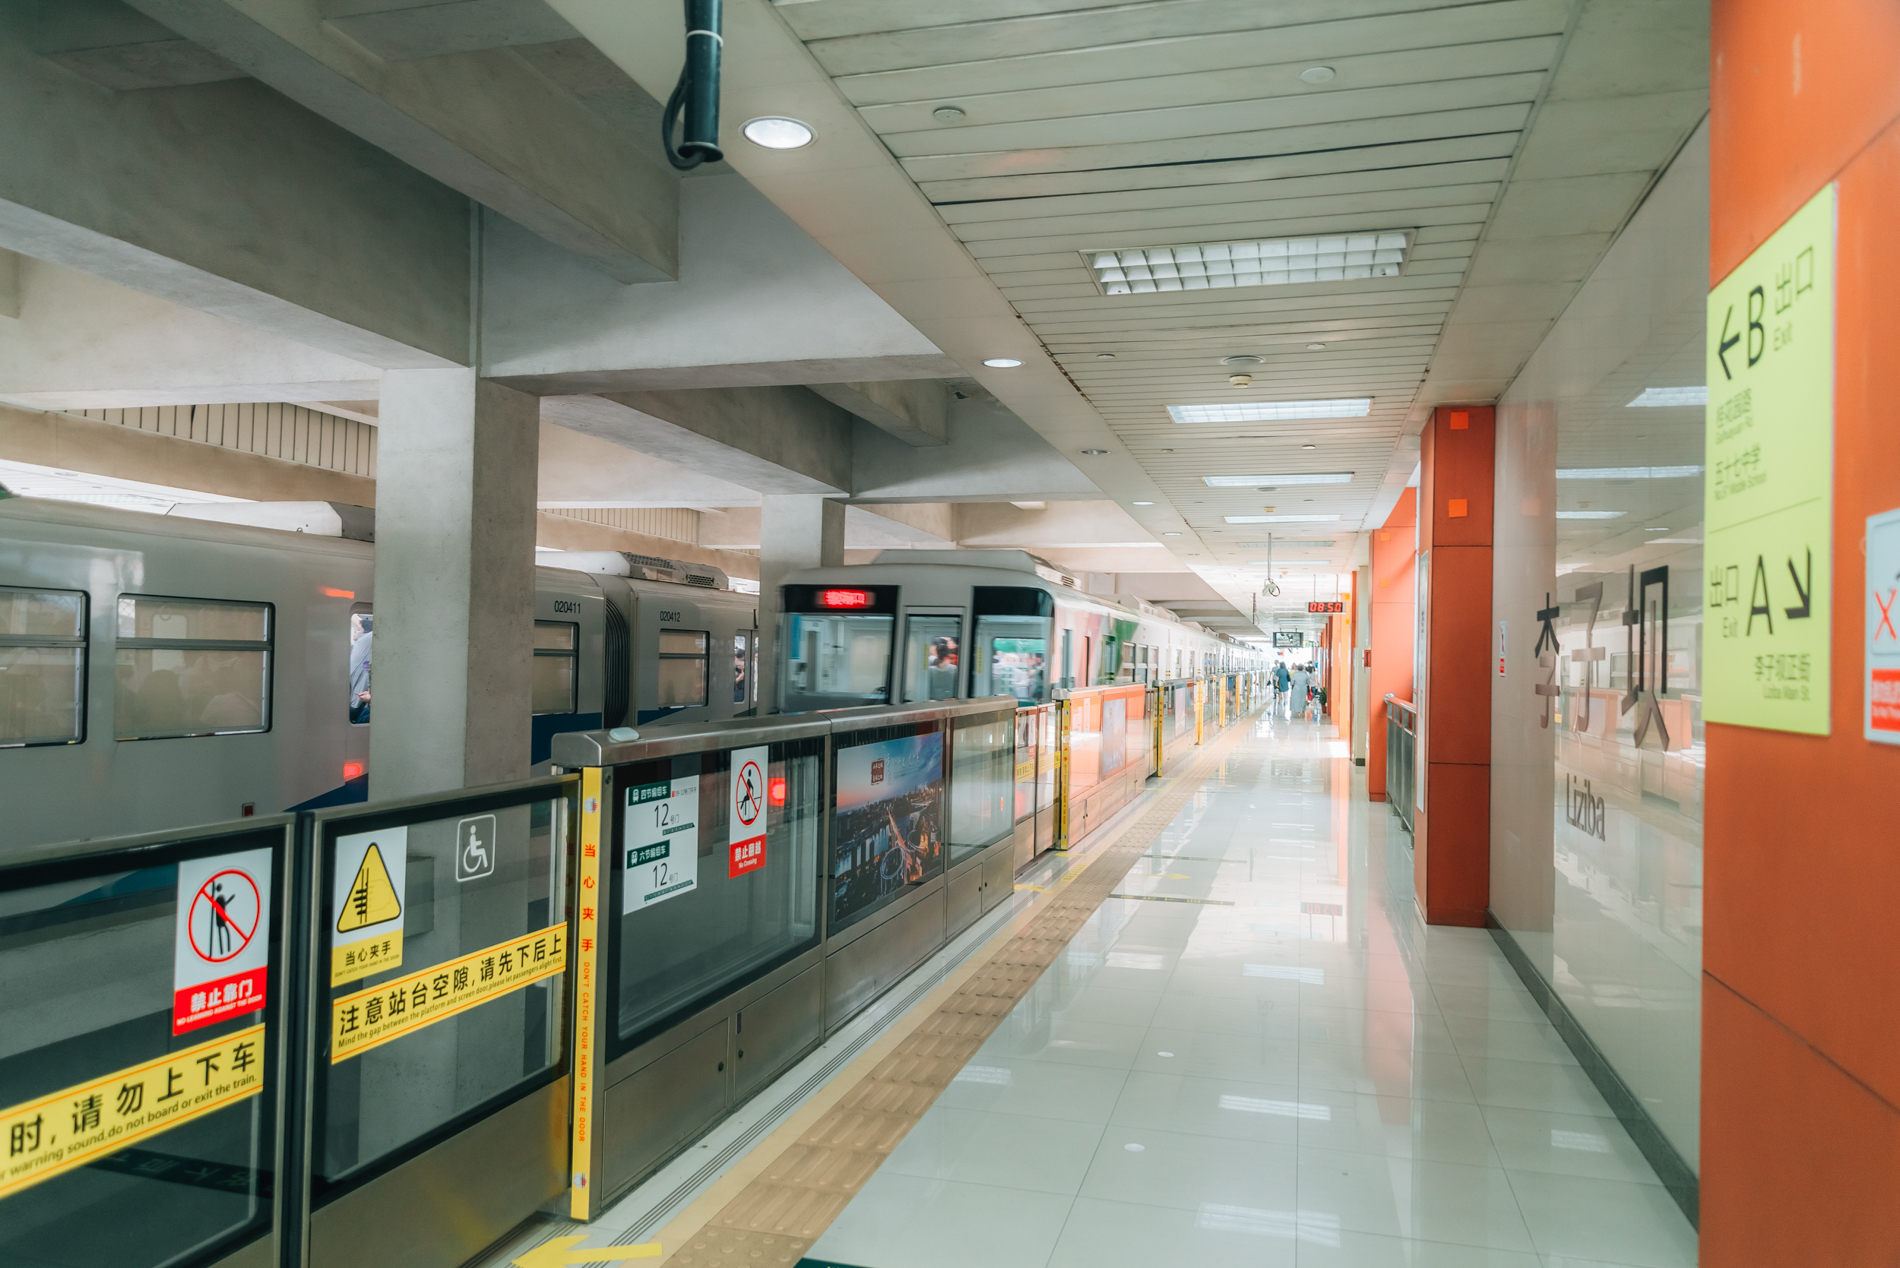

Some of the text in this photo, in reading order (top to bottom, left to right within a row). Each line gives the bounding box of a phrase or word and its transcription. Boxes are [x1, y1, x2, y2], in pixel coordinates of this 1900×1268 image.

[1774, 244, 1814, 317] 出口
[1748, 284, 1765, 370] B
[1773, 321, 1793, 352] Exit
[1709, 564, 1739, 608] 出口
[1746, 554, 1774, 637] A
[554, 600, 581, 614] 020411
[660, 610, 680, 622] 020412
[1309, 602, 1342, 612] 08:50
[1722, 616, 1738, 638] Exit
[1535, 563, 1670, 752] 李子坝
[654, 803, 669, 828] 12
[1566, 773, 1605, 842] Liziba
[653, 862, 668, 888] 12
[582, 843, 596, 952] 当心夹手
[345, 940, 391, 967] 当心夹手
[583, 961, 591, 988] DON'T
[176, 1016, 187, 1027] NO
[214, 1001, 237, 1015] AGAINST
[237, 997, 248, 1008] THE
[248, 994, 263, 1004] DOOR
[191, 978, 253, 1014] 禁止靠门
[338, 1035, 356, 1048] Mind
[357, 1031, 368, 1041] the
[369, 1026, 382, 1039] gap
[382, 1015, 409, 1031] between
[409, 1011, 420, 1021] the
[420, 1000, 446, 1018] platform
[446, 995, 457, 1006] and
[458, 990, 475, 1002] screen
[512, 966, 539, 981] passengers
[582, 992, 590, 1021] CATCH
[580, 1082, 587, 1091] IN
[579, 1096, 587, 1113] THE
[10, 1148, 64, 1176] warning
[126, 1115, 145, 1131] not
[147, 1100, 179, 1122] board
[181, 1098, 193, 1110] or
[194, 1089, 213, 1104] exit
[215, 1080, 231, 1096] the
[578, 1117, 586, 1142] DOOR
